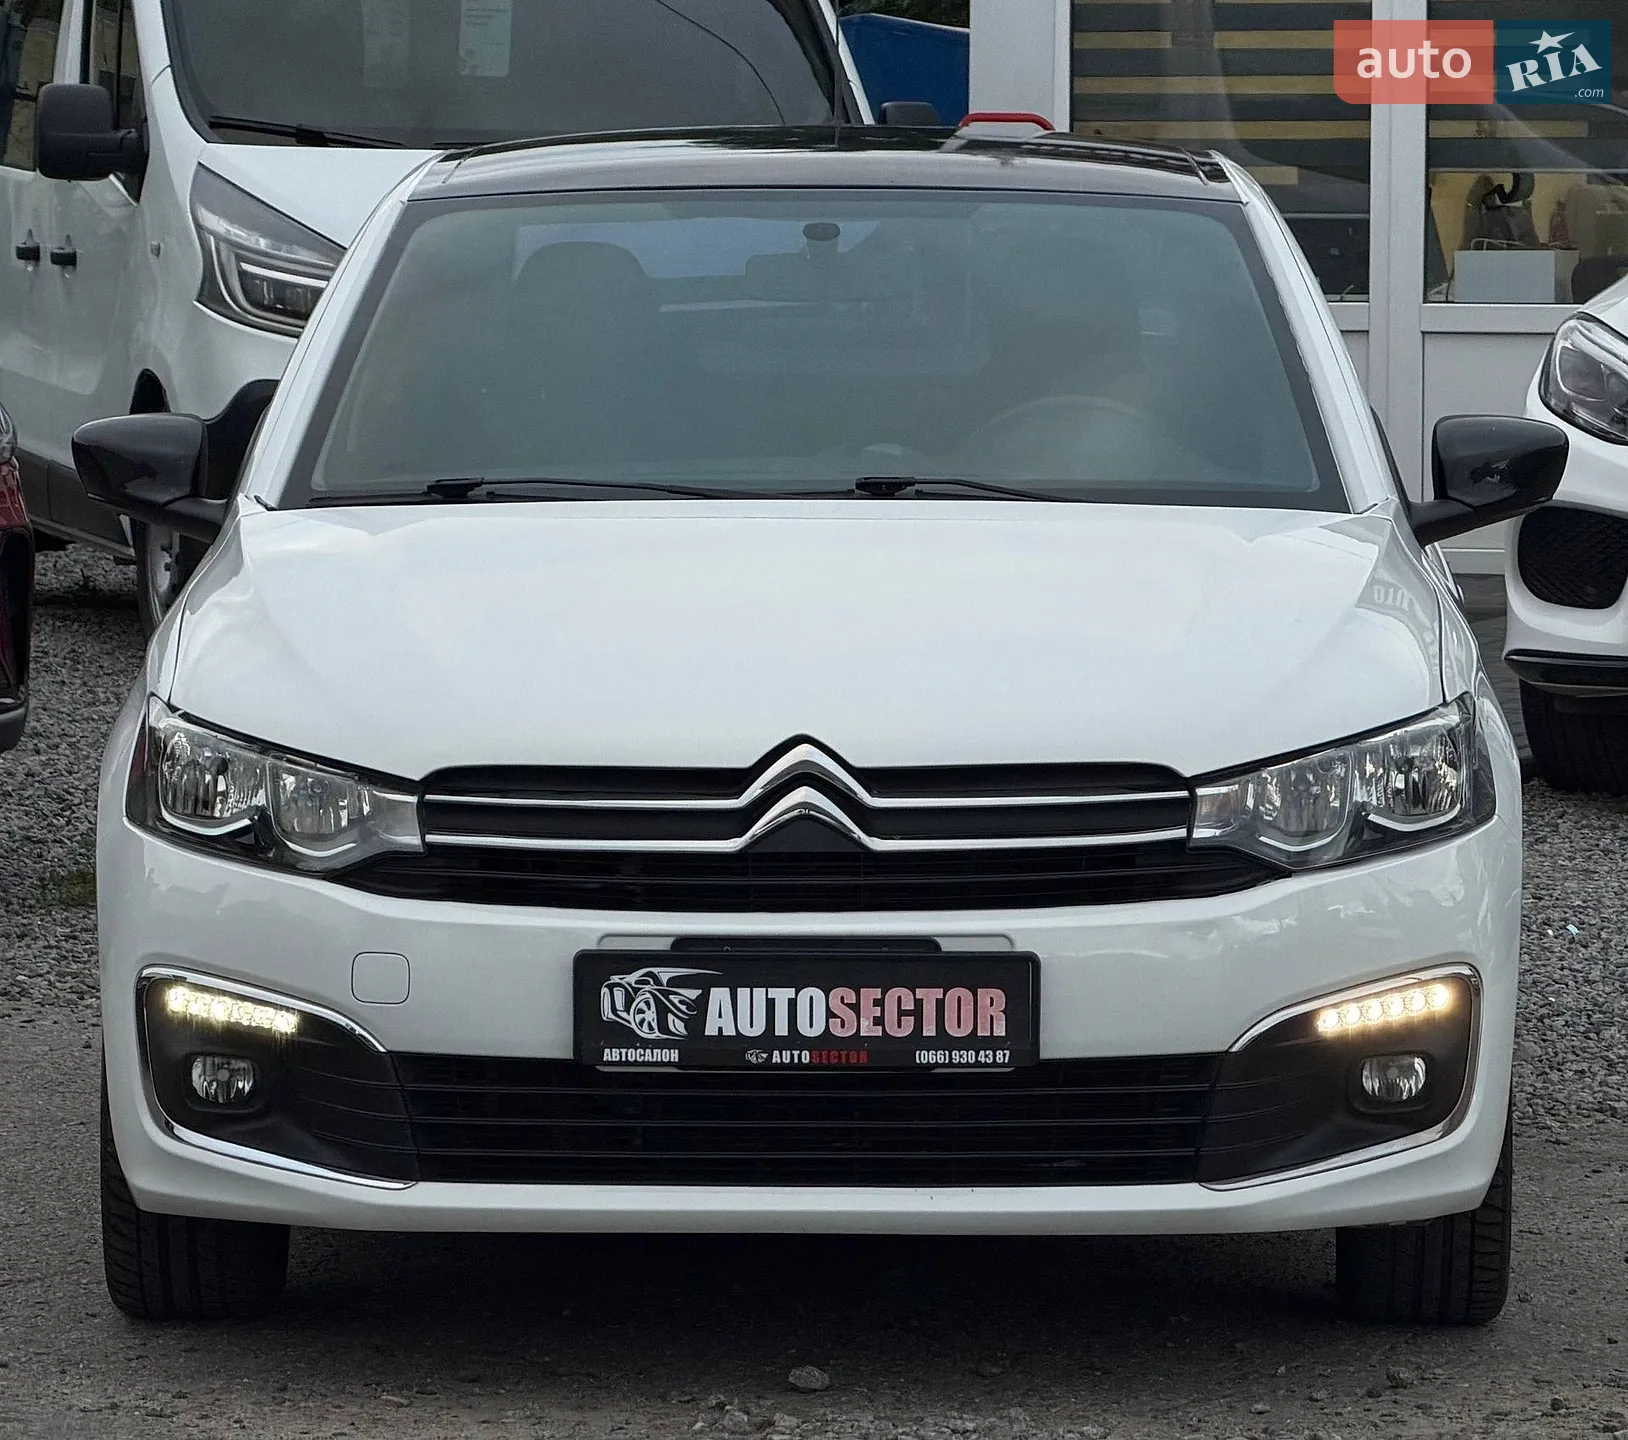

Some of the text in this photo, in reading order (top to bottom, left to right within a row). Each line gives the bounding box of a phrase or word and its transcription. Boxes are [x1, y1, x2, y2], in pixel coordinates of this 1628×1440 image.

[704, 987, 1006, 1037] AUTOSECTOR
[603, 1048, 679, 1063] АВТОСАЛОН
[771, 1050, 868, 1064] AUTOSECTOR
[915, 1050, 1010, 1064] (066) 930 43 87
